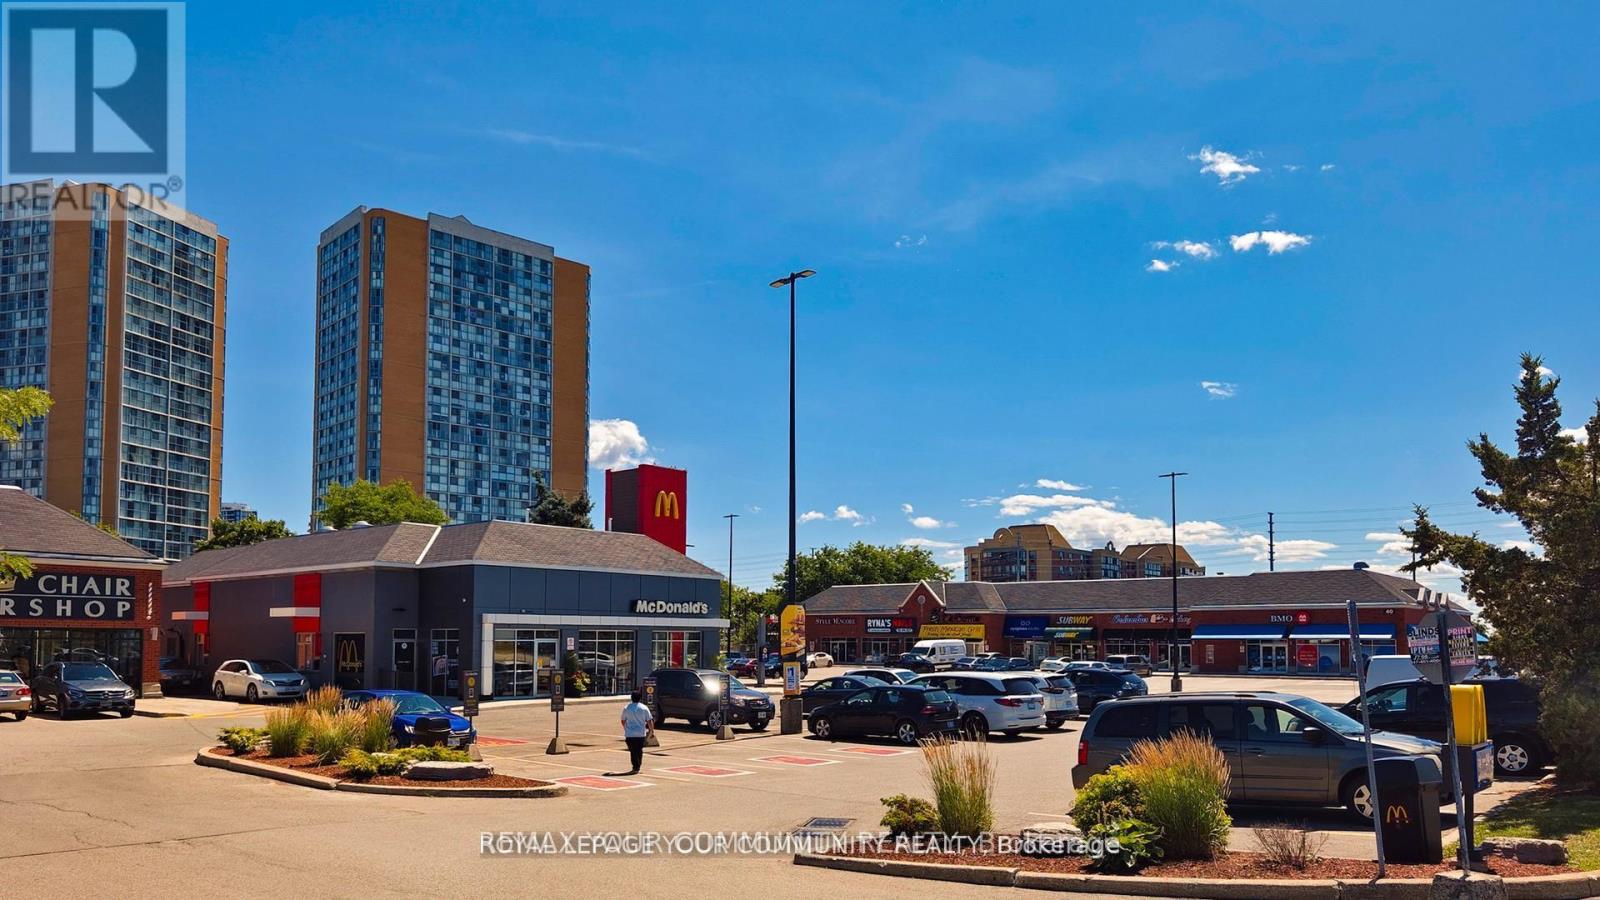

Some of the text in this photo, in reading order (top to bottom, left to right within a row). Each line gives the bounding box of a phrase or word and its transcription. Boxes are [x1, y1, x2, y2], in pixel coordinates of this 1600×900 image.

[37, 575, 132, 597] CHAIR
[29, 598, 131, 618] SHOP
[635, 600, 709, 615] McDonald's
[867, 619, 892, 628] RYNA'S
[1056, 616, 1093, 625] SUBWAY
[1270, 615, 1293, 623] BMO
[1408, 626, 1440, 637] BLINDS
[1447, 627, 1472, 636] PRINT
